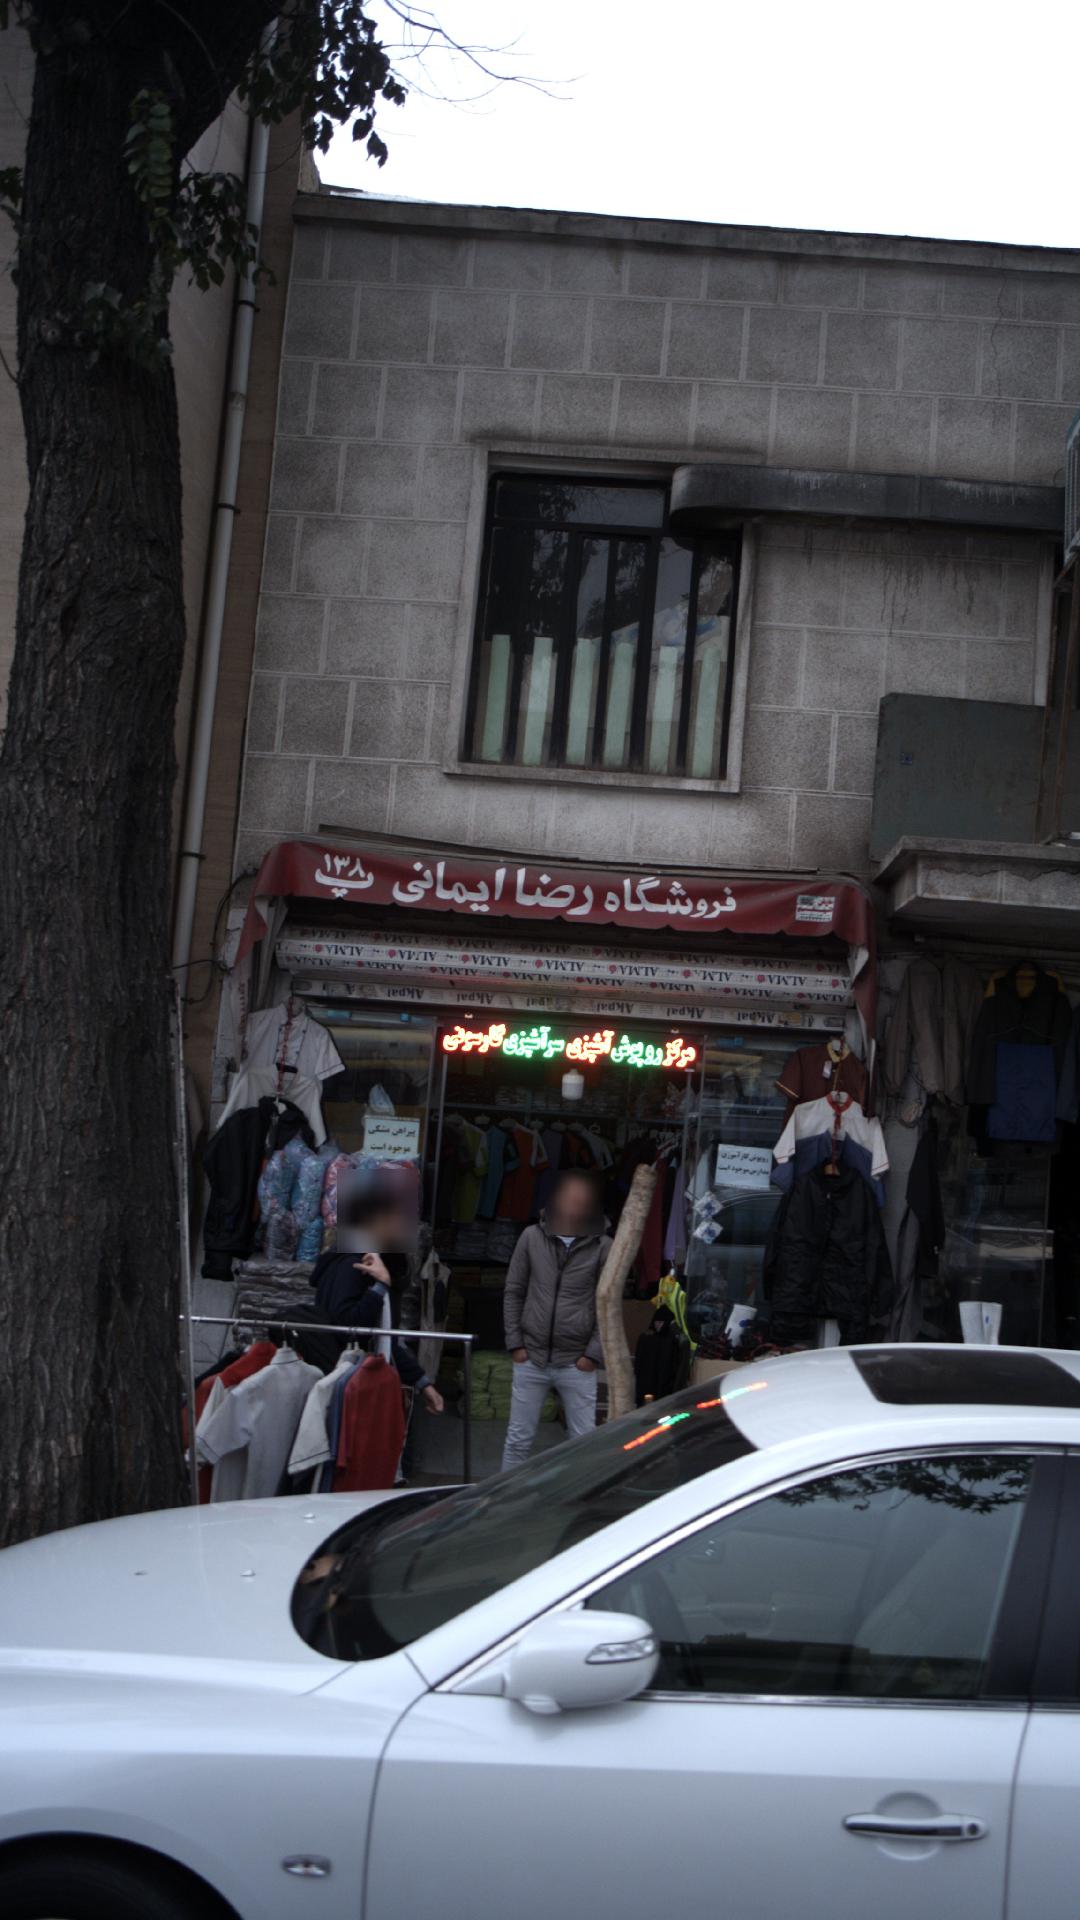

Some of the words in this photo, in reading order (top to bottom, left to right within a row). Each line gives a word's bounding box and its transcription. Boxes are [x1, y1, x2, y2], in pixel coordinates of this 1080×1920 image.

[392, 861, 506, 912] ایمانی
[515, 867, 594, 916] رضا
[604, 876, 737, 919] فروشگاه
[325, 944, 364, 956] ALMA
[472, 954, 511, 967] ALMA
[546, 959, 585, 972] ALMA
[619, 964, 660, 977] ALMA
[700, 970, 733, 982] ALM
[768, 974, 808, 987] ALMA
[387, 987, 425, 999] Akpal
[456, 992, 495, 1004] Akpal
[596, 1001, 634, 1014] Akpal
[666, 1007, 705, 1019] Akpal
[566, 1030, 615, 1063] آشپزی
[662, 1038, 697, 1067] مرکز
[370, 1142, 387, 1150] است
